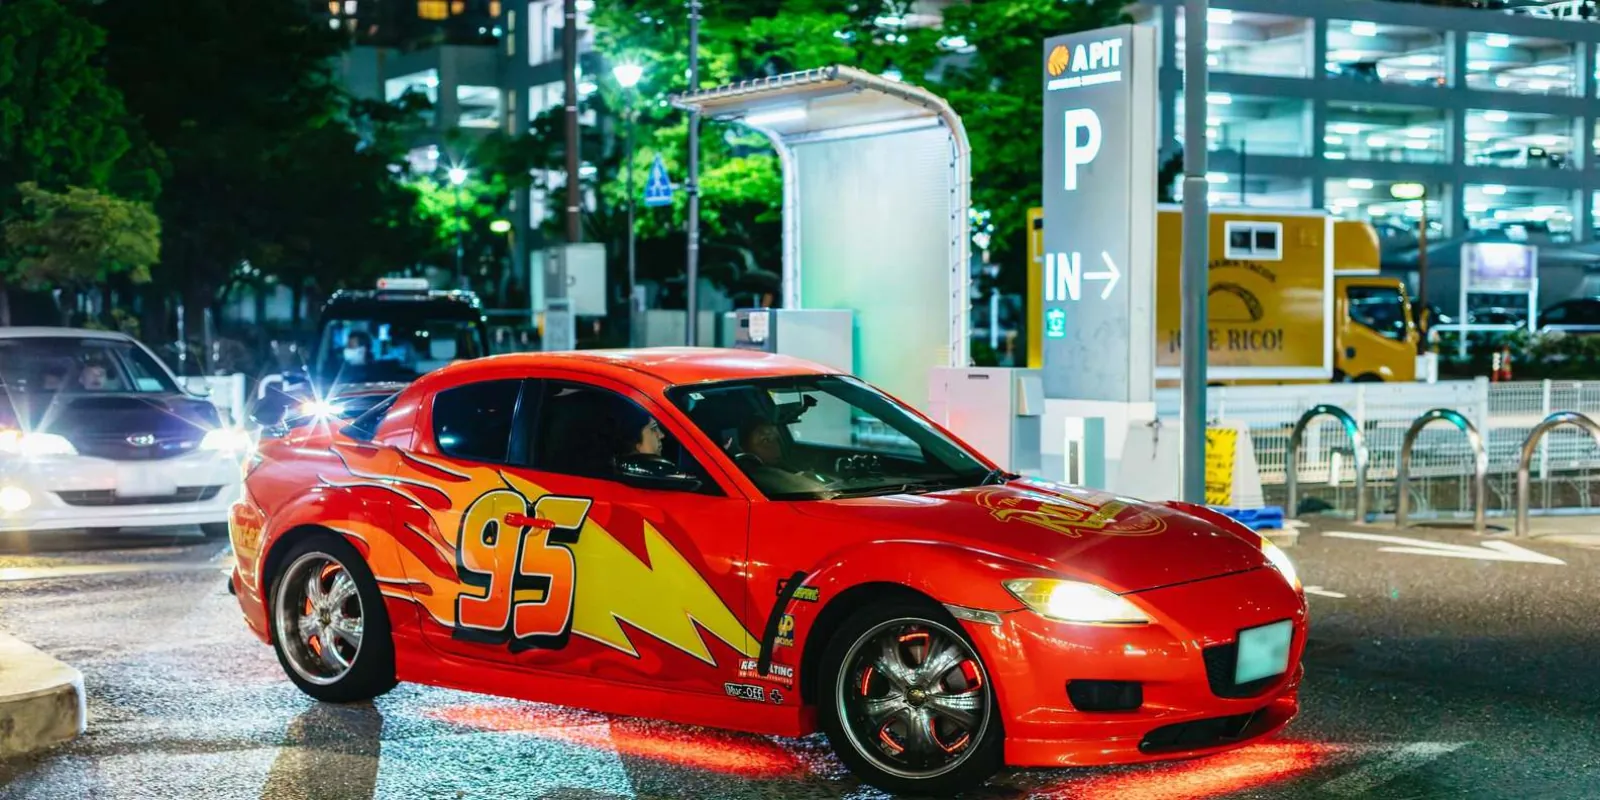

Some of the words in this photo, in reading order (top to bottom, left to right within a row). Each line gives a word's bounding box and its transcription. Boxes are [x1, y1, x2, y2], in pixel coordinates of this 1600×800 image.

[1072, 38, 1123, 72] APIT
[1065, 108, 1102, 190] P
[1045, 252, 1081, 301] IN
[1228, 328, 1284, 352] RICO!
[453, 489, 593, 651] 95
